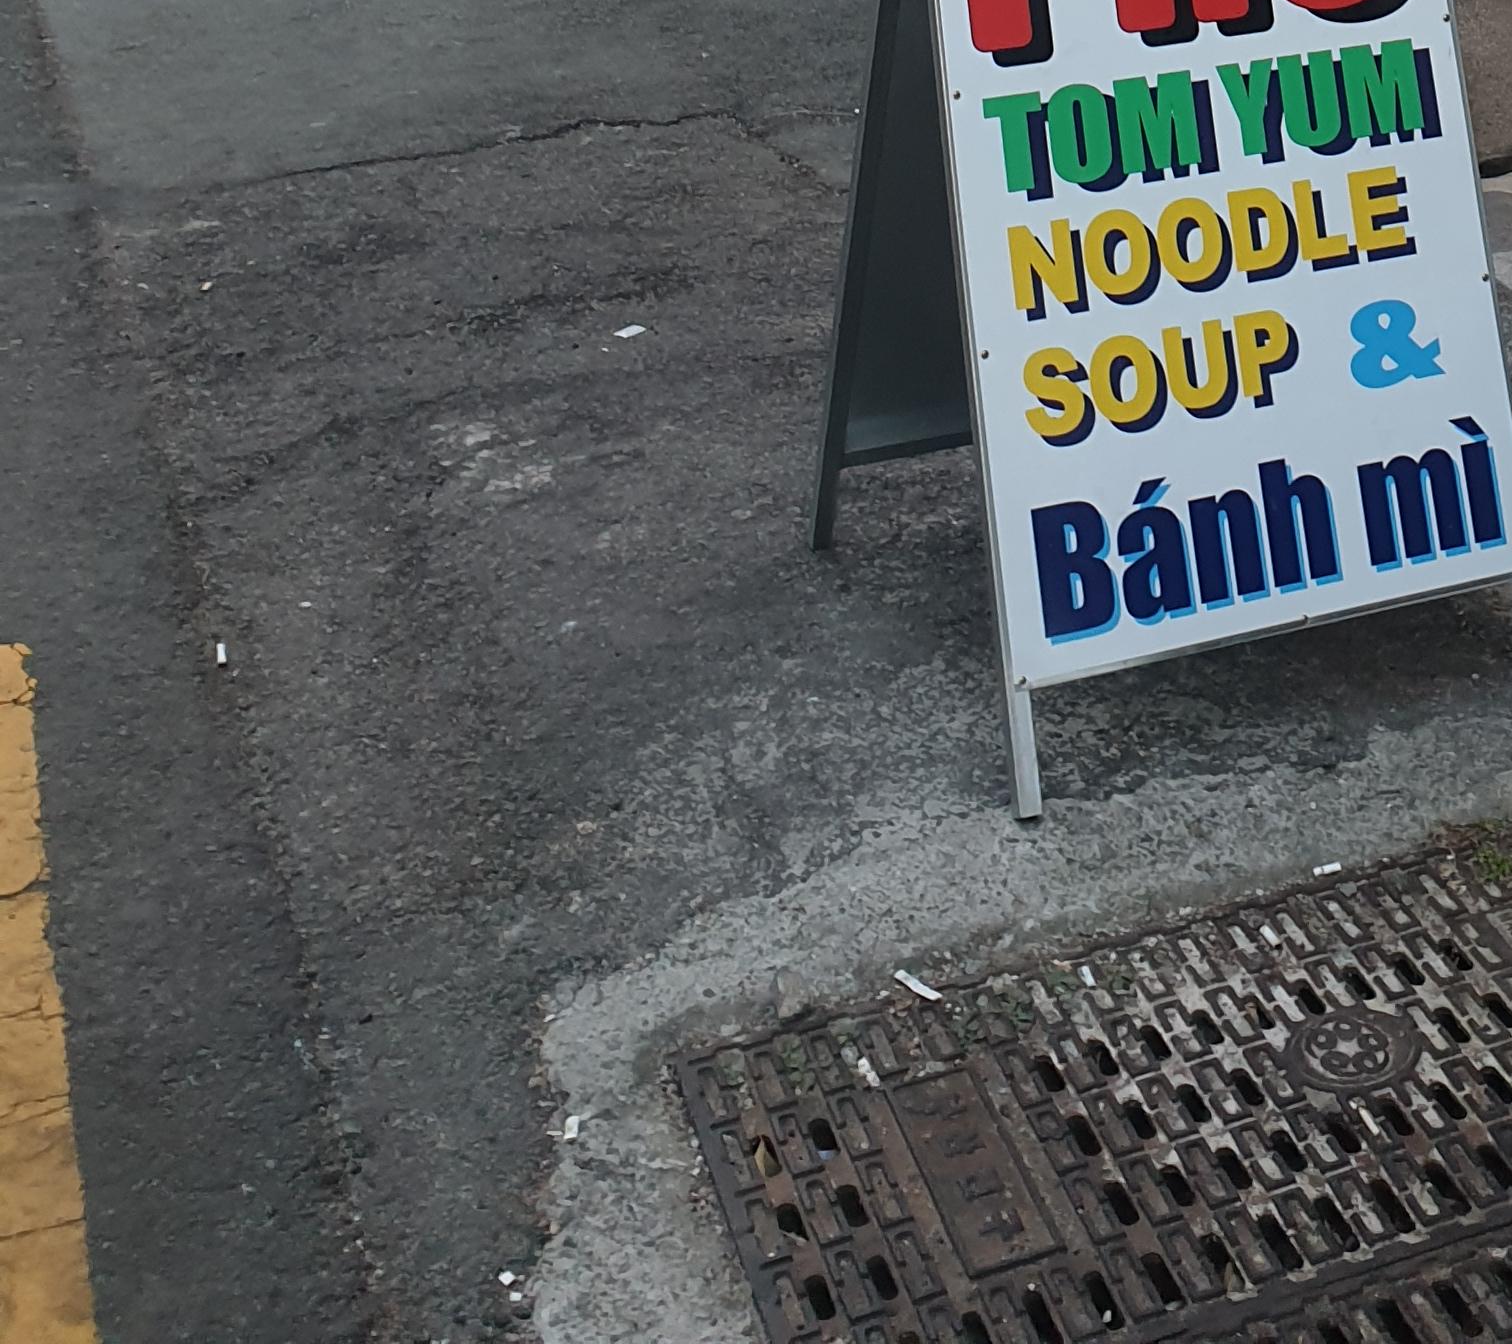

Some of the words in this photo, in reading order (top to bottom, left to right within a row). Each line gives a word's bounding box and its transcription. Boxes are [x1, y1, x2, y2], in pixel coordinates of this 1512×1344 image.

[982, 69, 1220, 202] TOM
[1215, 37, 1443, 164] YUM
[1005, 165, 1419, 323] NOODLE
[1022, 309, 1300, 449] SOUP
[1349, 298, 1446, 390] &
[1029, 458, 1345, 646] Bánh
[1357, 415, 1507, 573] mì
